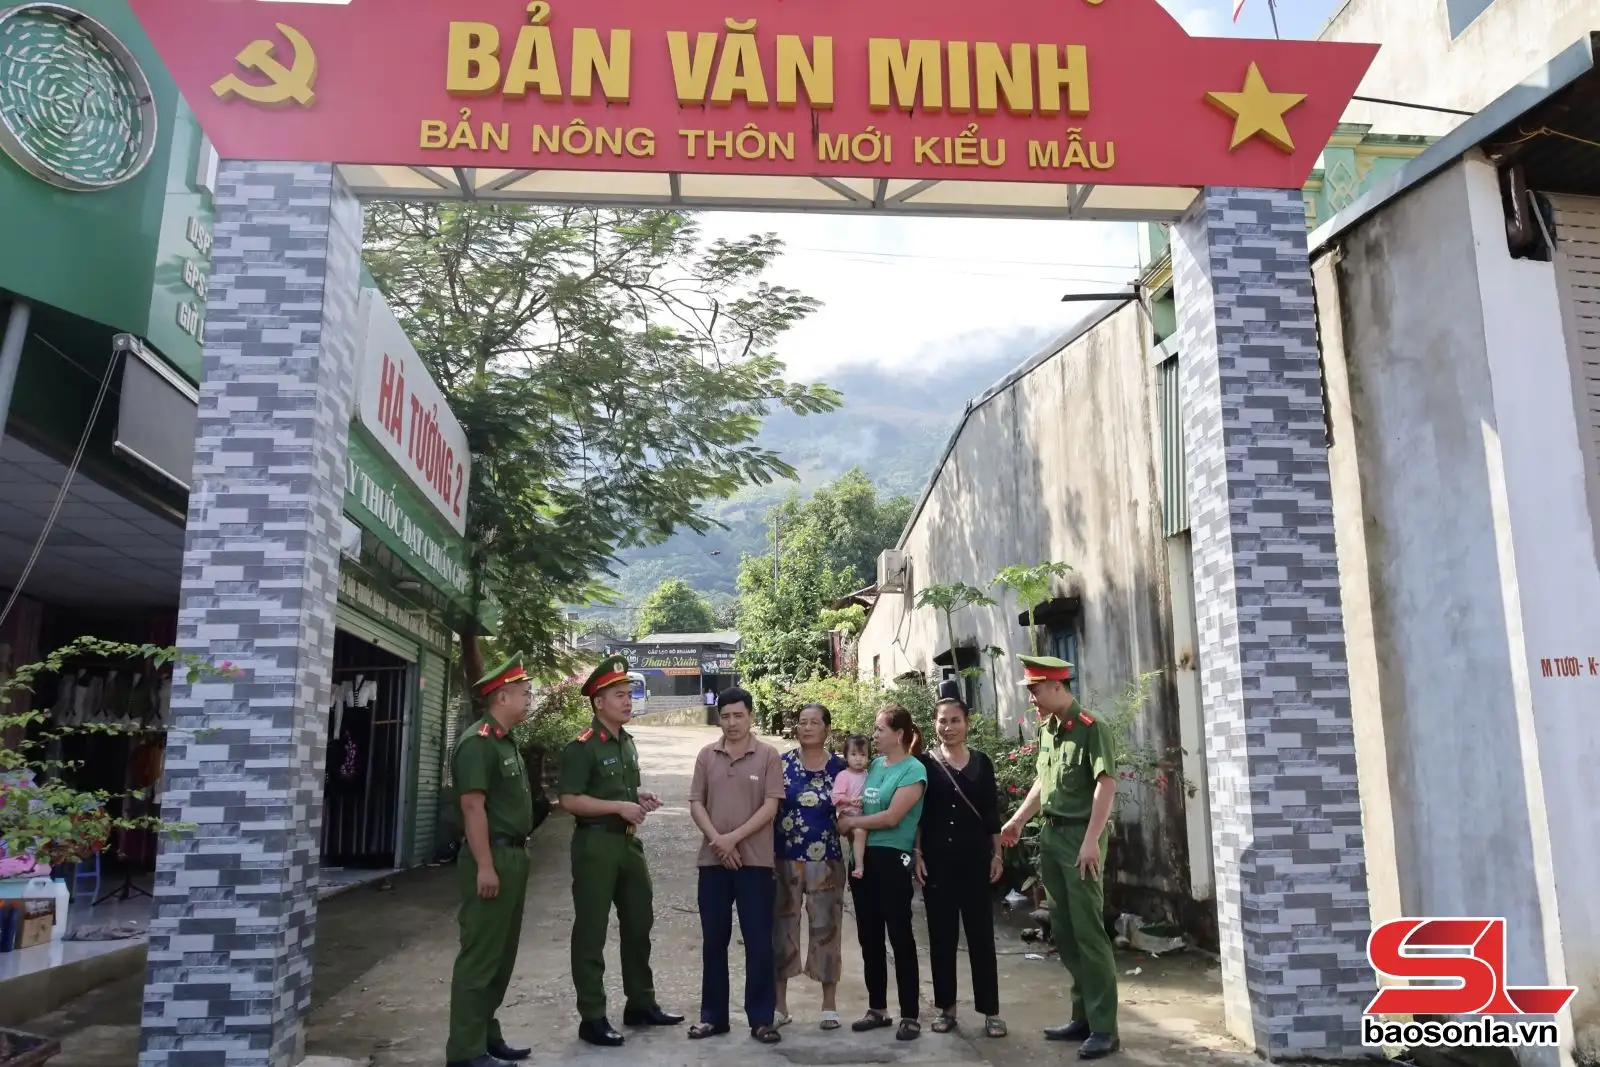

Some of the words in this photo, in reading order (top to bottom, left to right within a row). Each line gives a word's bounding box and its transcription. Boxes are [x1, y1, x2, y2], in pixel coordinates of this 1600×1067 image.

[446, 1, 631, 102] BẢN
[667, 17, 834, 108] VĂN
[869, 38, 1090, 115] MINH
[420, 108, 509, 151] BẢN
[532, 119, 656, 157] NÔNG
[680, 123, 795, 161] THÔN
[818, 125, 893, 164] MỚI
[914, 123, 1007, 167] KIỂU
[1028, 127, 1116, 170] MẪU
[378, 352, 404, 447] HÀ
[408, 393, 453, 505] TƯỞNG
[453, 462, 463, 518] 2
[360, 471, 403, 537] THUỐC
[402, 514, 424, 556] ĐẠT
